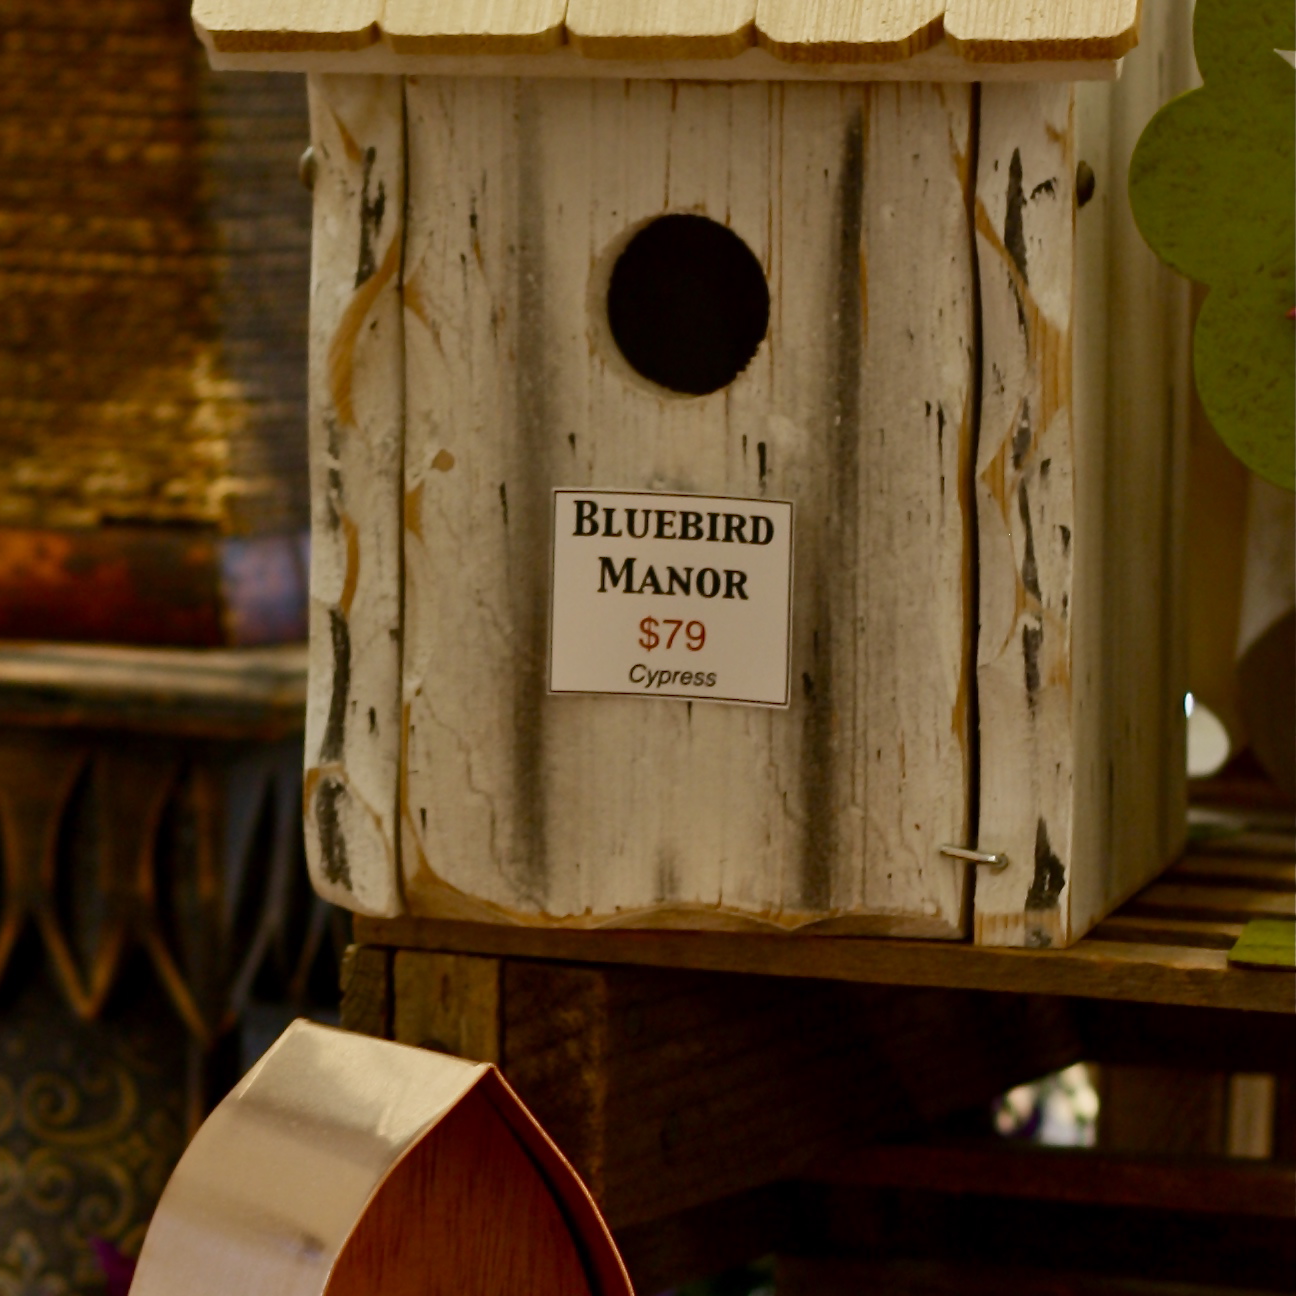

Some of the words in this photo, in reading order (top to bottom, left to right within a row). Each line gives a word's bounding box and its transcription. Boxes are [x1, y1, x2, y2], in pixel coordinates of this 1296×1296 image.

[572, 500, 774, 546] BLUEBIRD
[597, 556, 749, 601] MANOR
[638, 615, 706, 652] $79
[628, 663, 717, 688] Cypress
